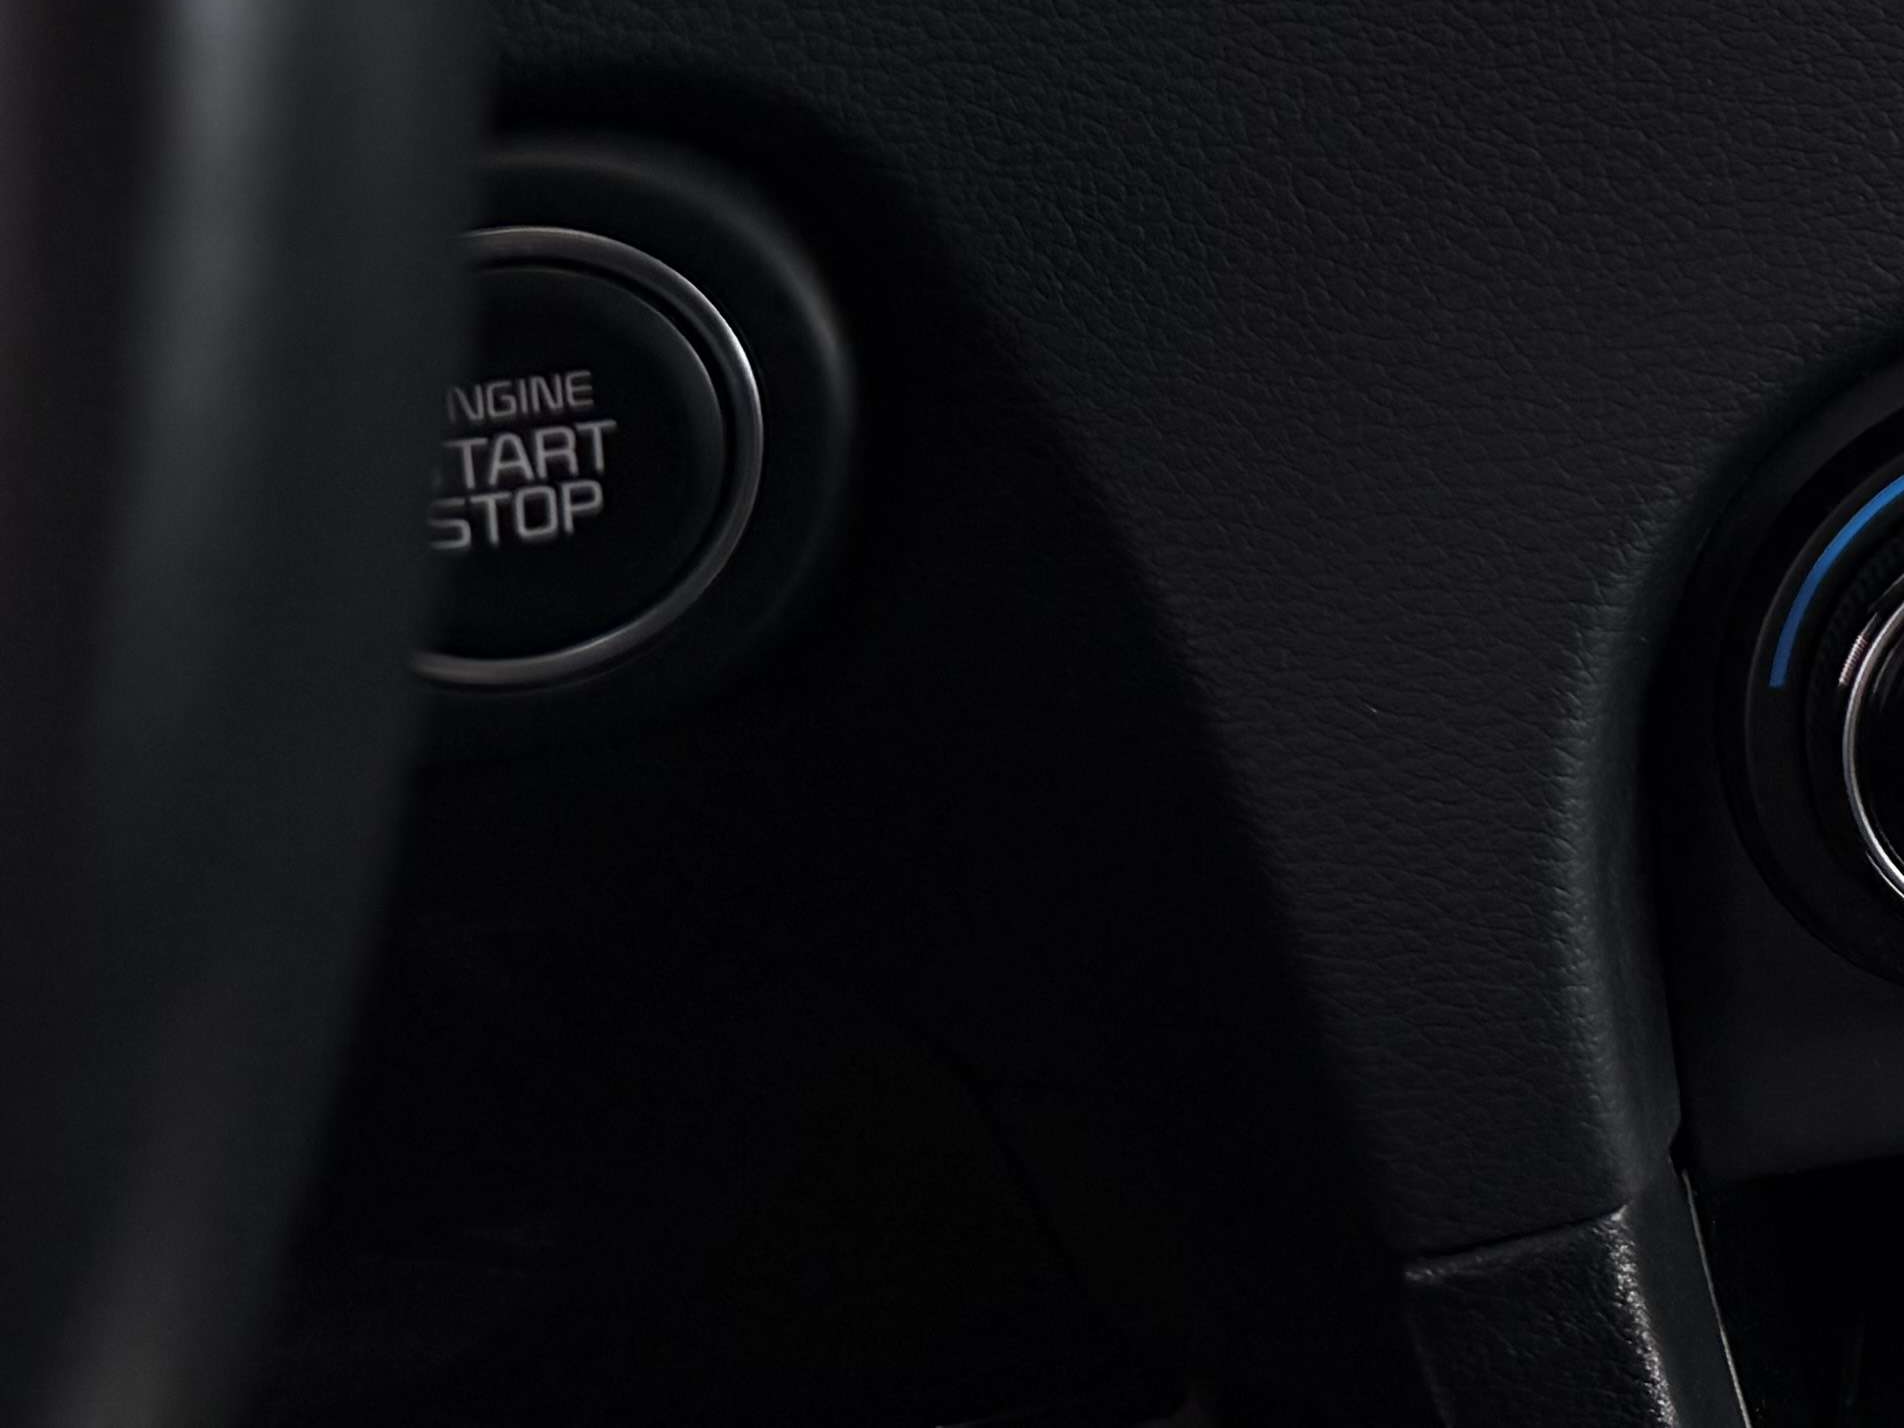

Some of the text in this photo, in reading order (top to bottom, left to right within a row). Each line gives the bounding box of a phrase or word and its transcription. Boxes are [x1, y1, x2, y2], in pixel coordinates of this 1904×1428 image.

[447, 370, 595, 424] NGINE
[442, 419, 618, 491] TART
[427, 479, 604, 551] STOP
